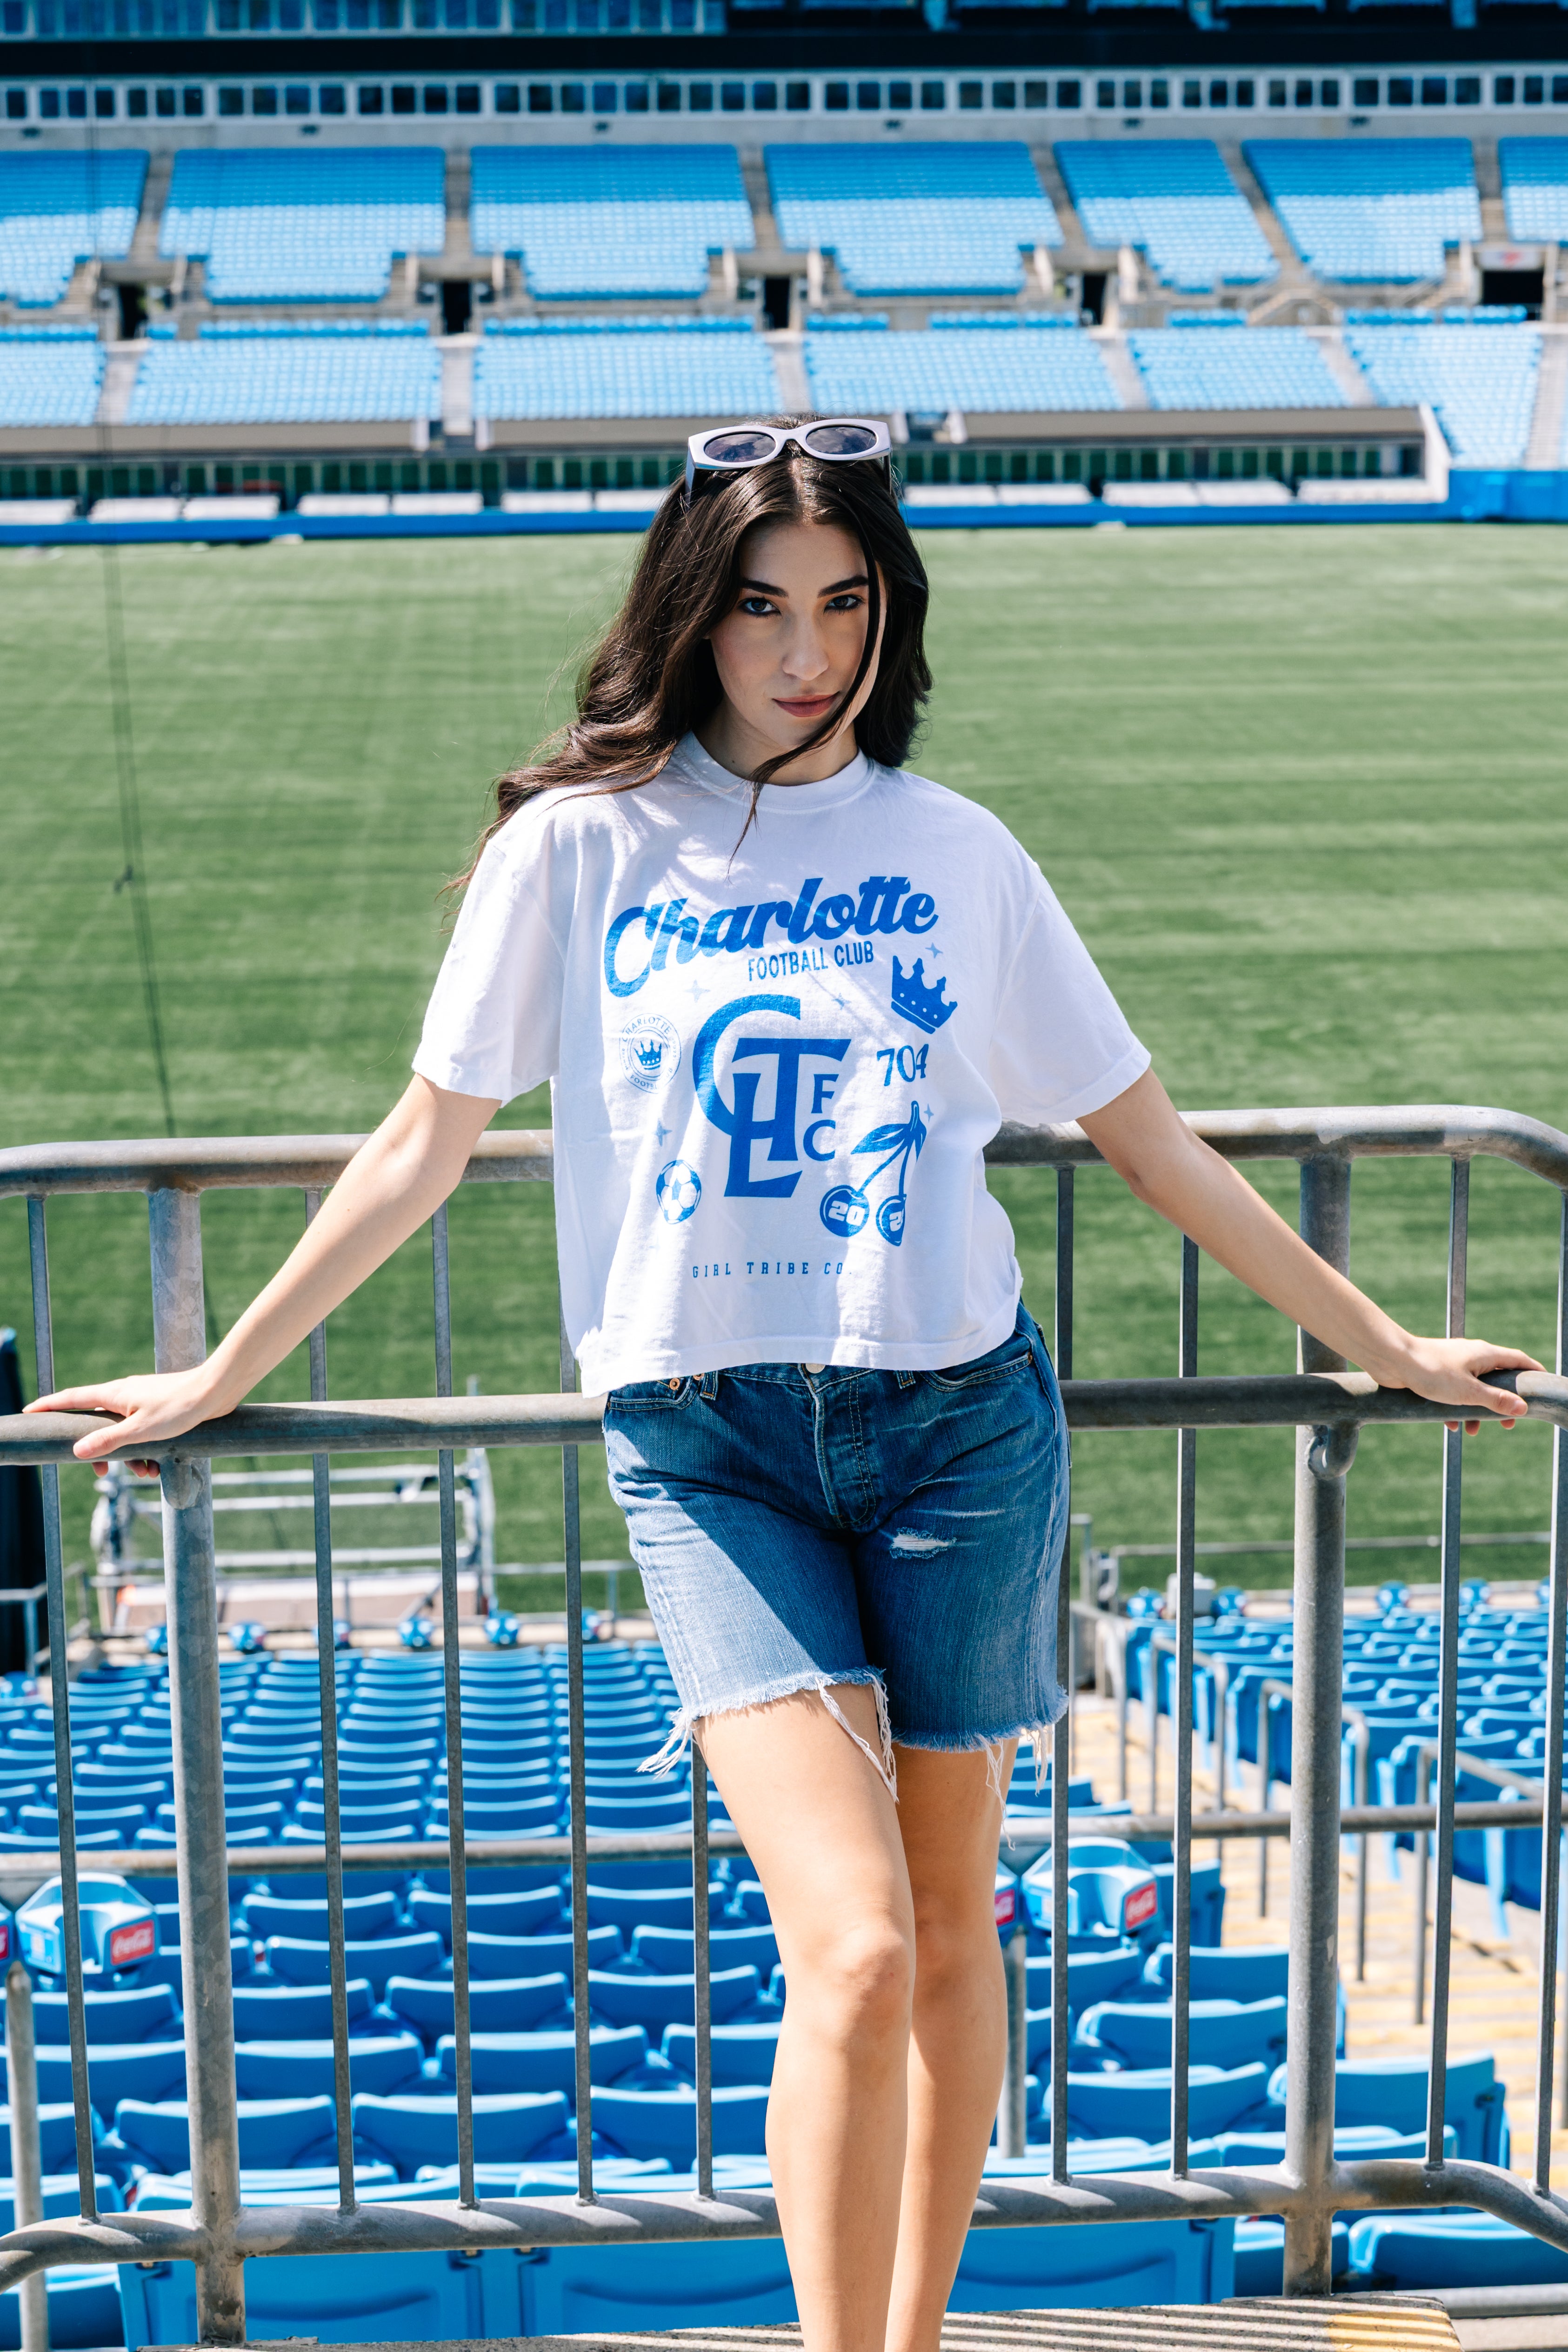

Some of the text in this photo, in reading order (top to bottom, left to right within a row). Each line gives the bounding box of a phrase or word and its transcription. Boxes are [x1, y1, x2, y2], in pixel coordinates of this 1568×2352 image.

[604, 876, 939, 997] Charlotte
[748, 941, 874, 982] FOOTBALL CLUB
[876, 1043, 929, 1086] 704
[828, 1200, 866, 1226] 20
[692, 1262, 852, 1278] GIRL TRIBE CO.
